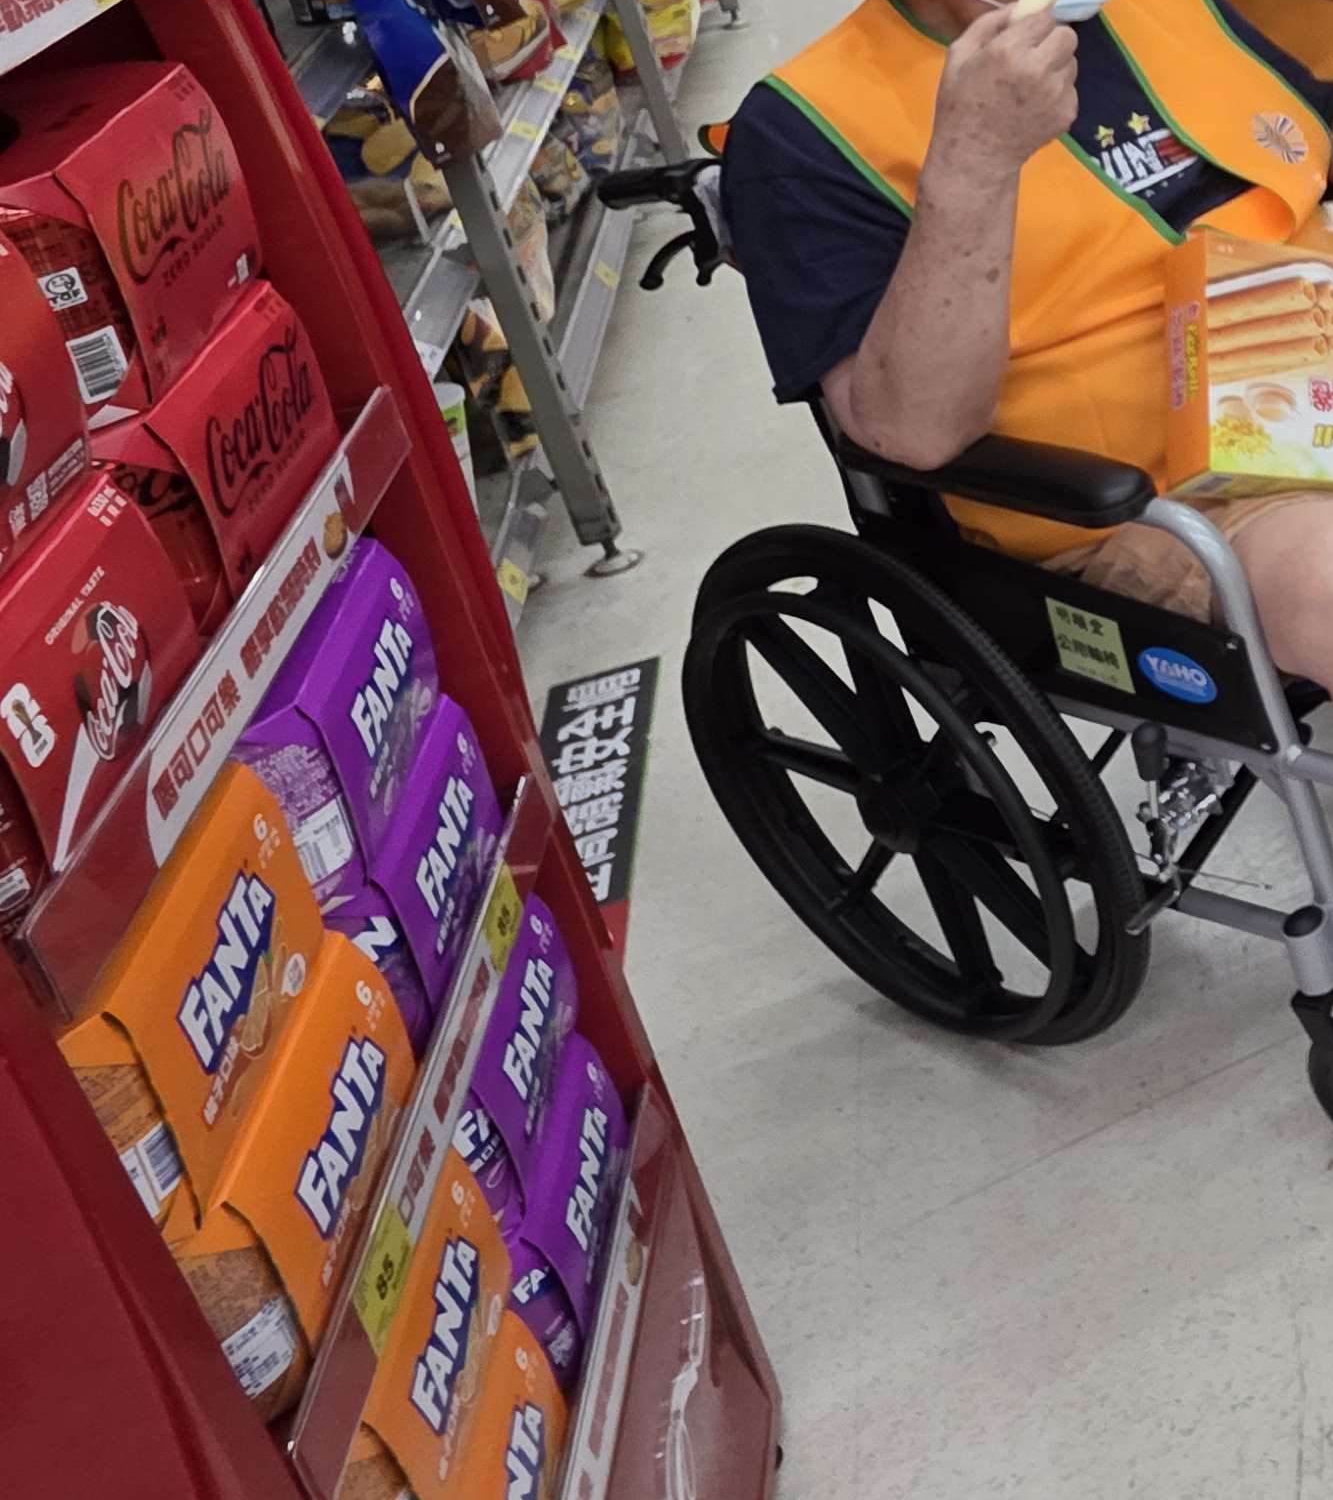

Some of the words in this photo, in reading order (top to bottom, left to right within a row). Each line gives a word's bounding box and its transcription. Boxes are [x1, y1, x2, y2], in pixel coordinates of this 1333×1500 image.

[117, 104, 230, 286] Coca-Cola
[205, 325, 314, 519] Coca-Cola
[350, 618, 413, 759] FANTA
[415, 776, 475, 919] FANTA
[178, 871, 275, 1069] FANTA
[502, 958, 554, 1101] FANTA
[298, 1037, 386, 1235] FANTA
[565, 1106, 608, 1252] FANTA
[411, 1238, 479, 1434] FANTA
